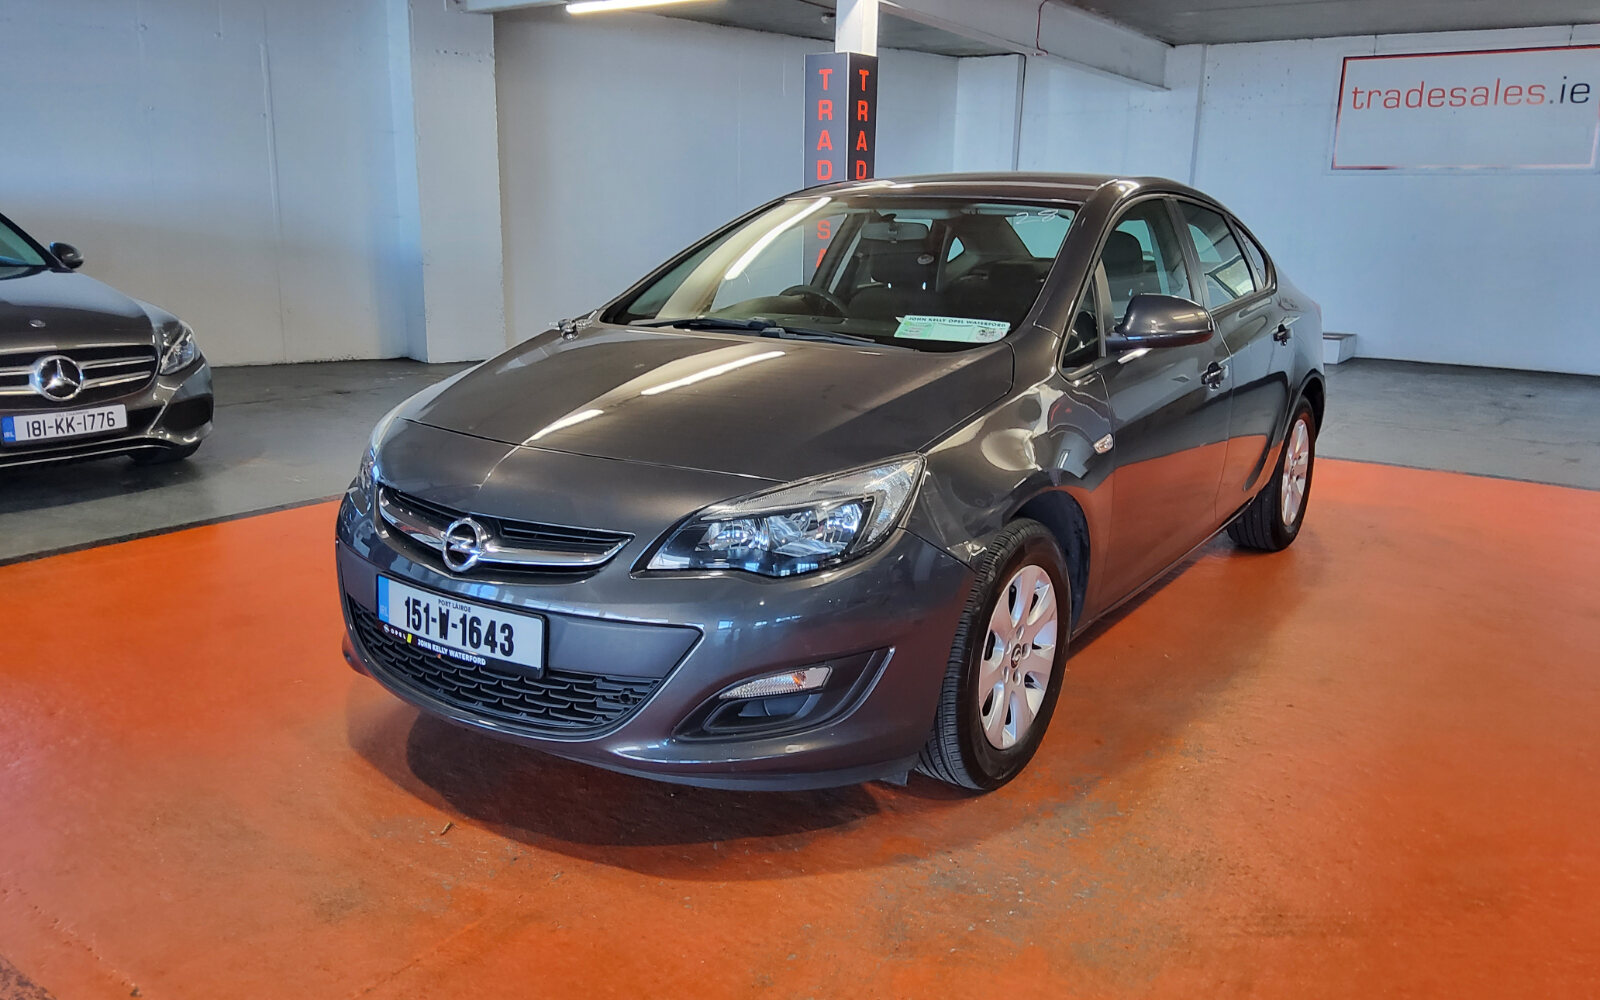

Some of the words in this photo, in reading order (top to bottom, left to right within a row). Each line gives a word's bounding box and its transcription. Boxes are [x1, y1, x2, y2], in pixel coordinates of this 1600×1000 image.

[1351, 75, 1591, 110] tradesales.ie
[966, 320, 1007, 328] WATERFORD
[26, 411, 116, 438] 181-KK-1776
[438, 598, 451, 608] PORT
[404, 595, 515, 658] 151-W-1643
[417, 638, 432, 650] JOHN
[431, 643, 449, 655] KELLY
[449, 649, 487, 666] WATERFORD
